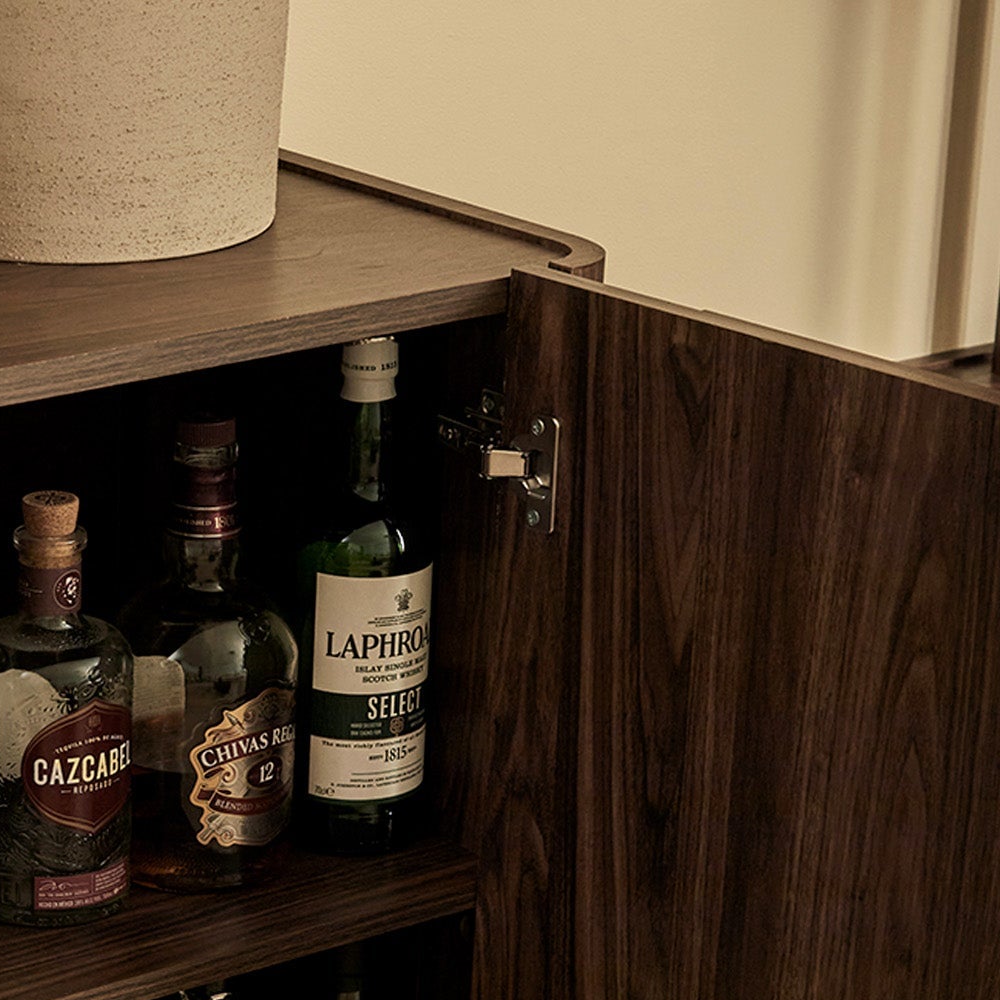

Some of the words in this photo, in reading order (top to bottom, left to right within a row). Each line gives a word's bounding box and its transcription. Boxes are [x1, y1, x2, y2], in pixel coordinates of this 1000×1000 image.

[368, 686, 422, 720] SELECT
[33, 739, 131, 786] CAZCABEL
[200, 733, 269, 768] CHIVAS
[384, 746, 408, 763] 1815
[258, 761, 274, 784] 12
